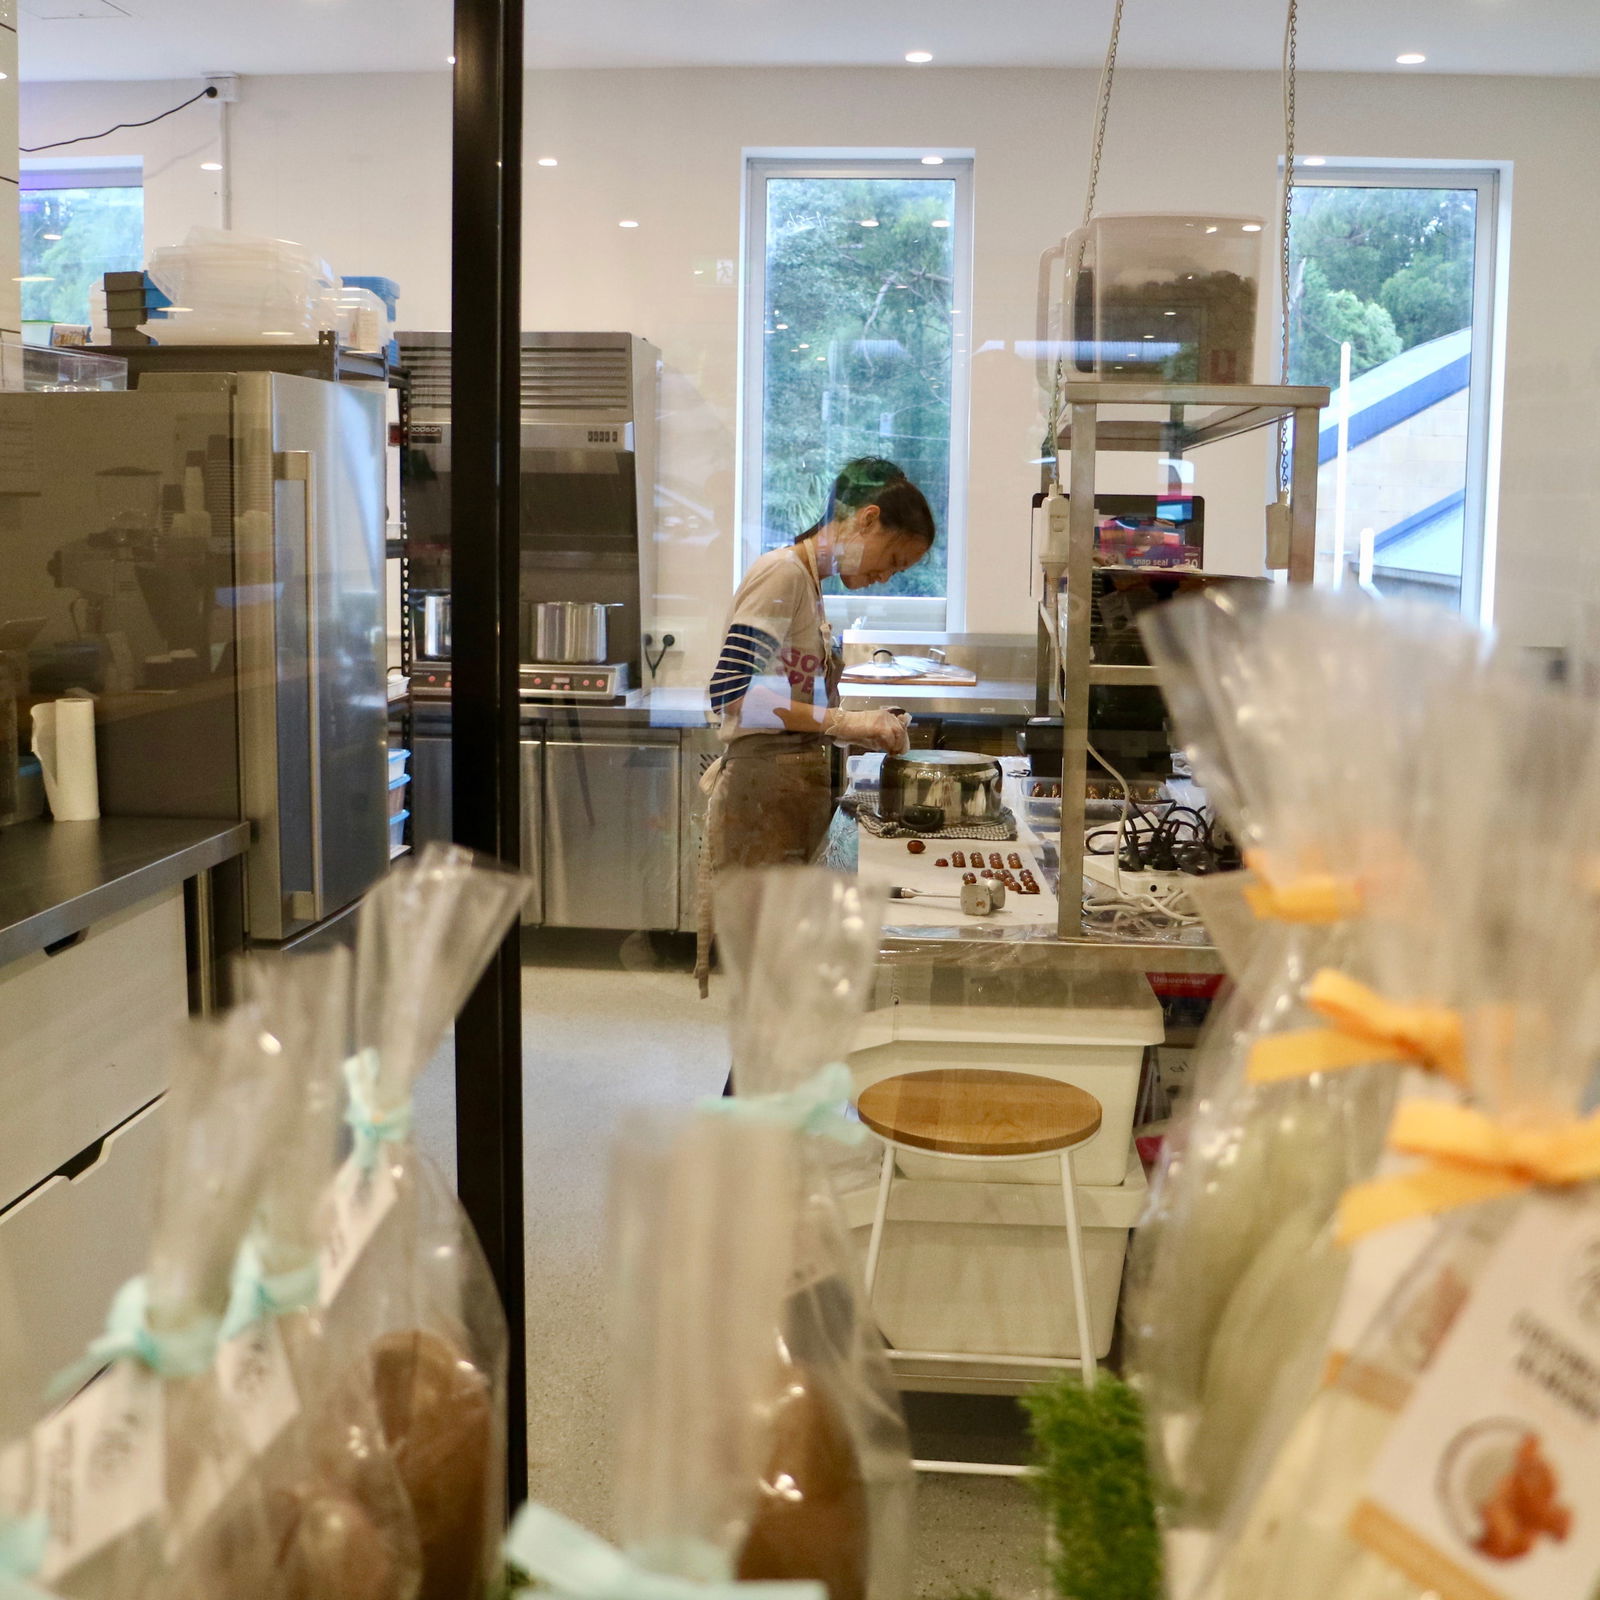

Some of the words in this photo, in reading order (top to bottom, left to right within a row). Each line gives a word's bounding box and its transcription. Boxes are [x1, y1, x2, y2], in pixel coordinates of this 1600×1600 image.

[1133, 558, 1151, 567] snap
[1153, 558, 1169, 566] seal
[1153, 975, 1207, 985] Unsweetened
